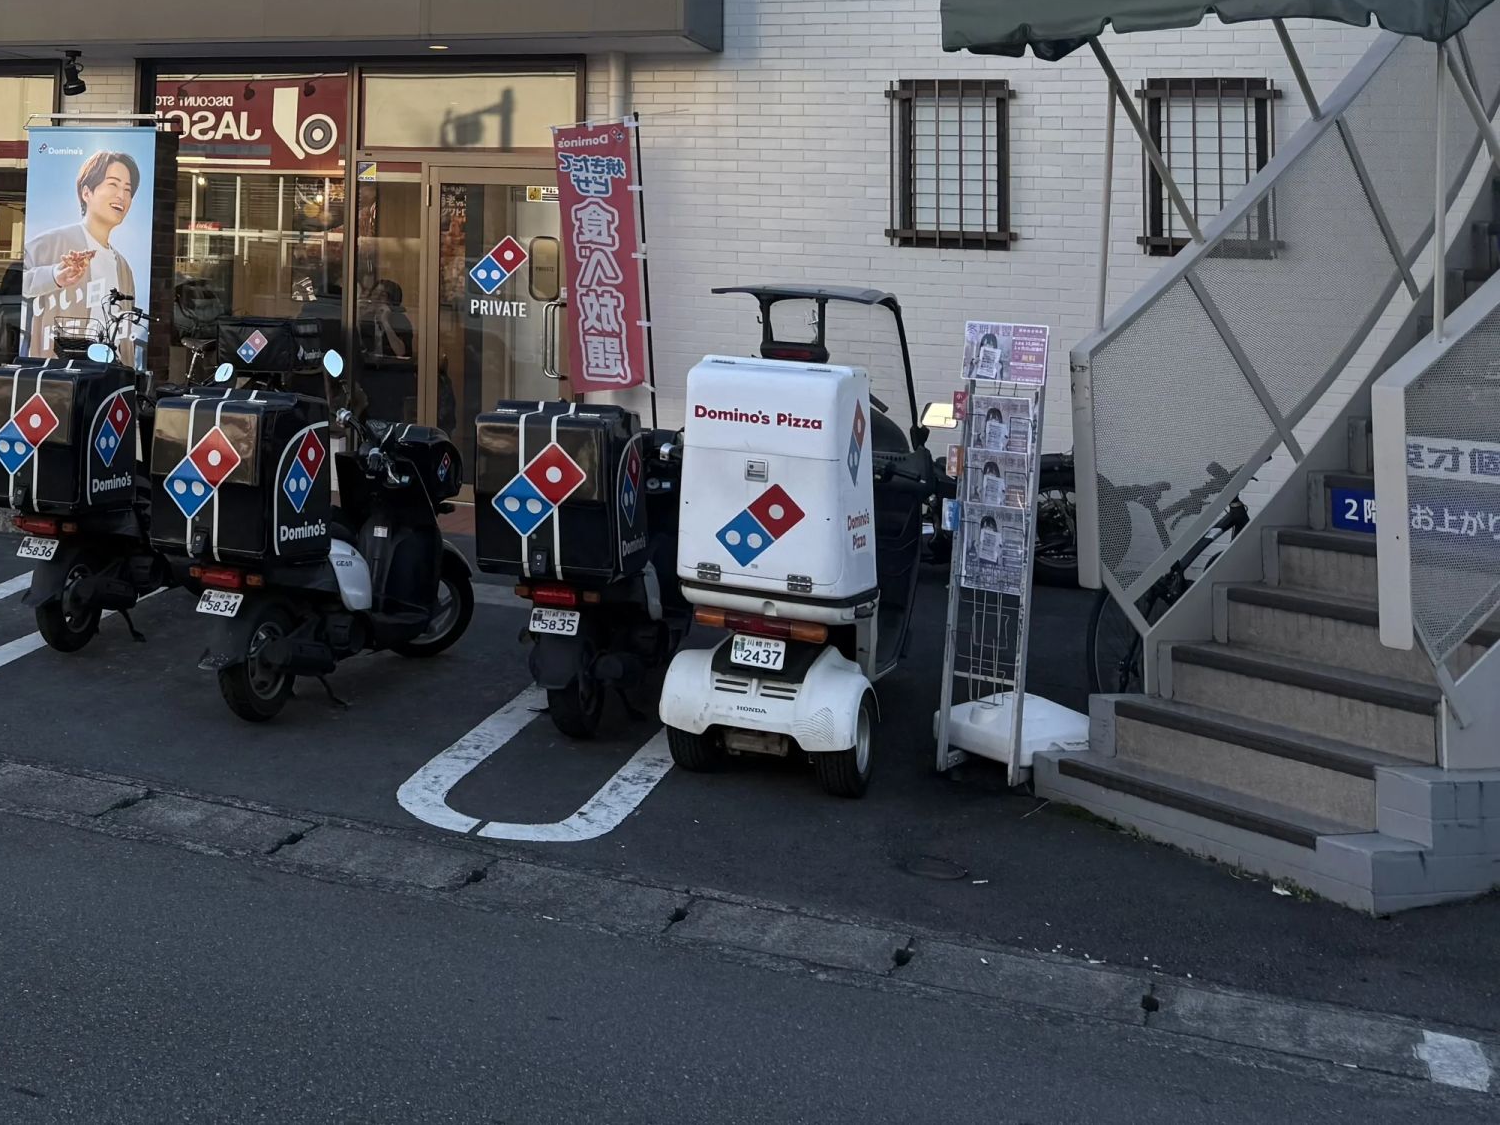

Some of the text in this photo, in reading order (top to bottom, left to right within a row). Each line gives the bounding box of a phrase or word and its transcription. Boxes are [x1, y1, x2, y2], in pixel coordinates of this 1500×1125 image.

[48, 146, 84, 155] Domino's
[470, 299, 527, 318] PRIVATE
[694, 404, 823, 430] Domino's Pizza
[92, 471, 132, 493] Domino's
[280, 518, 326, 542] Domino's
[26, 545, 54, 558] 5836
[206, 600, 238, 614] 5834
[540, 618, 577, 632] 5835
[742, 649, 782, 666] 2437
[736, 705, 767, 714] HONDA
